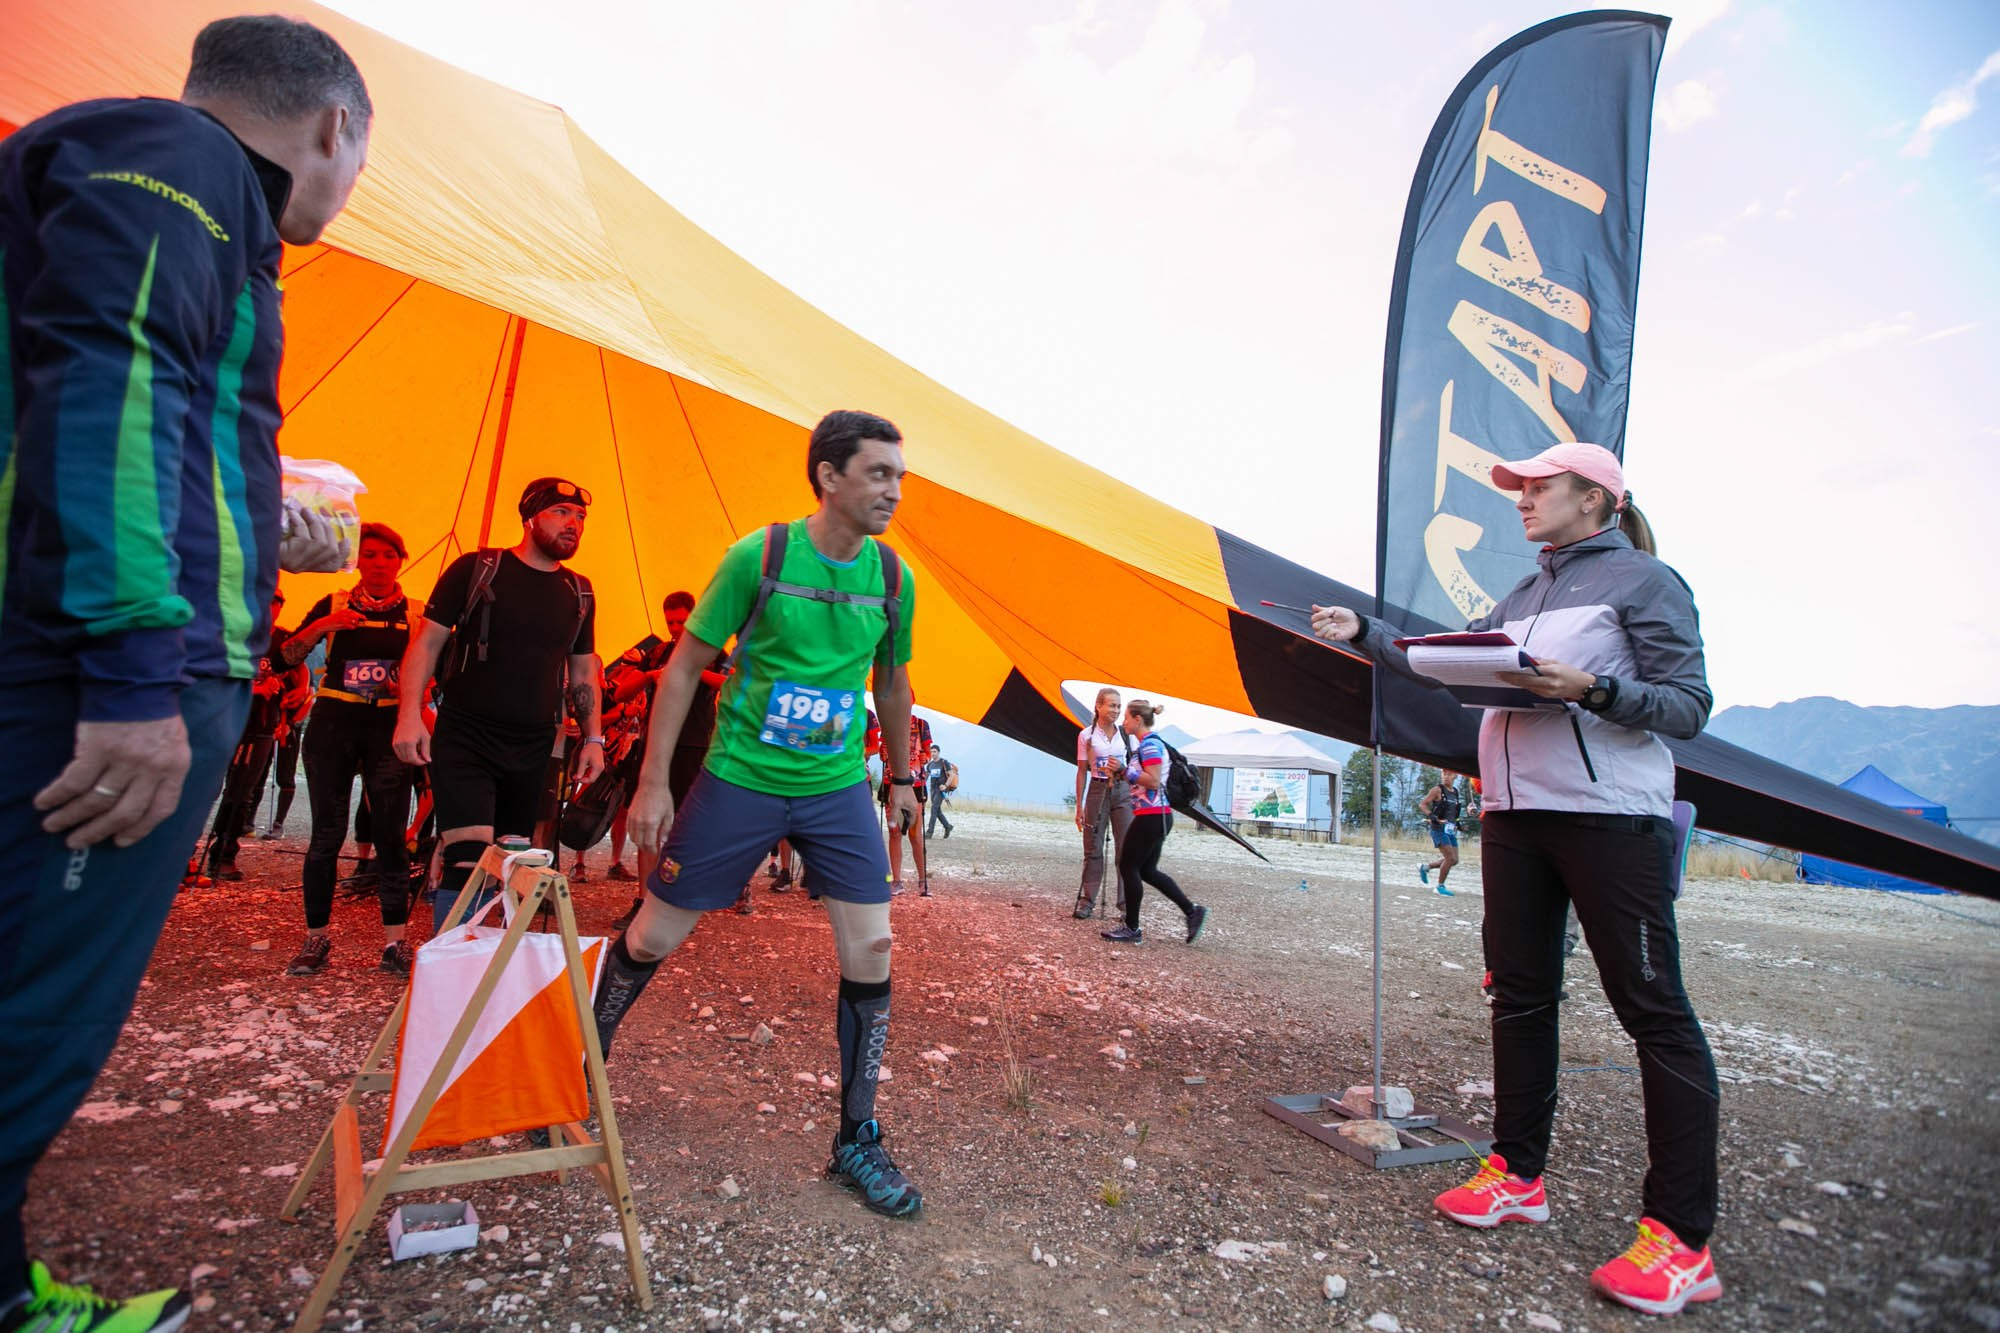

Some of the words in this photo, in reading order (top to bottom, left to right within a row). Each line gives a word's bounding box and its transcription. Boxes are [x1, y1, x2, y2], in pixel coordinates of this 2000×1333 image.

[348, 666, 386, 682] 160
[777, 693, 830, 723] 198
[1287, 772, 1306, 780] 2020
[599, 987, 629, 1022] SOCKS
[872, 1009, 889, 1025] X
[864, 1024, 888, 1080] SOCKS
